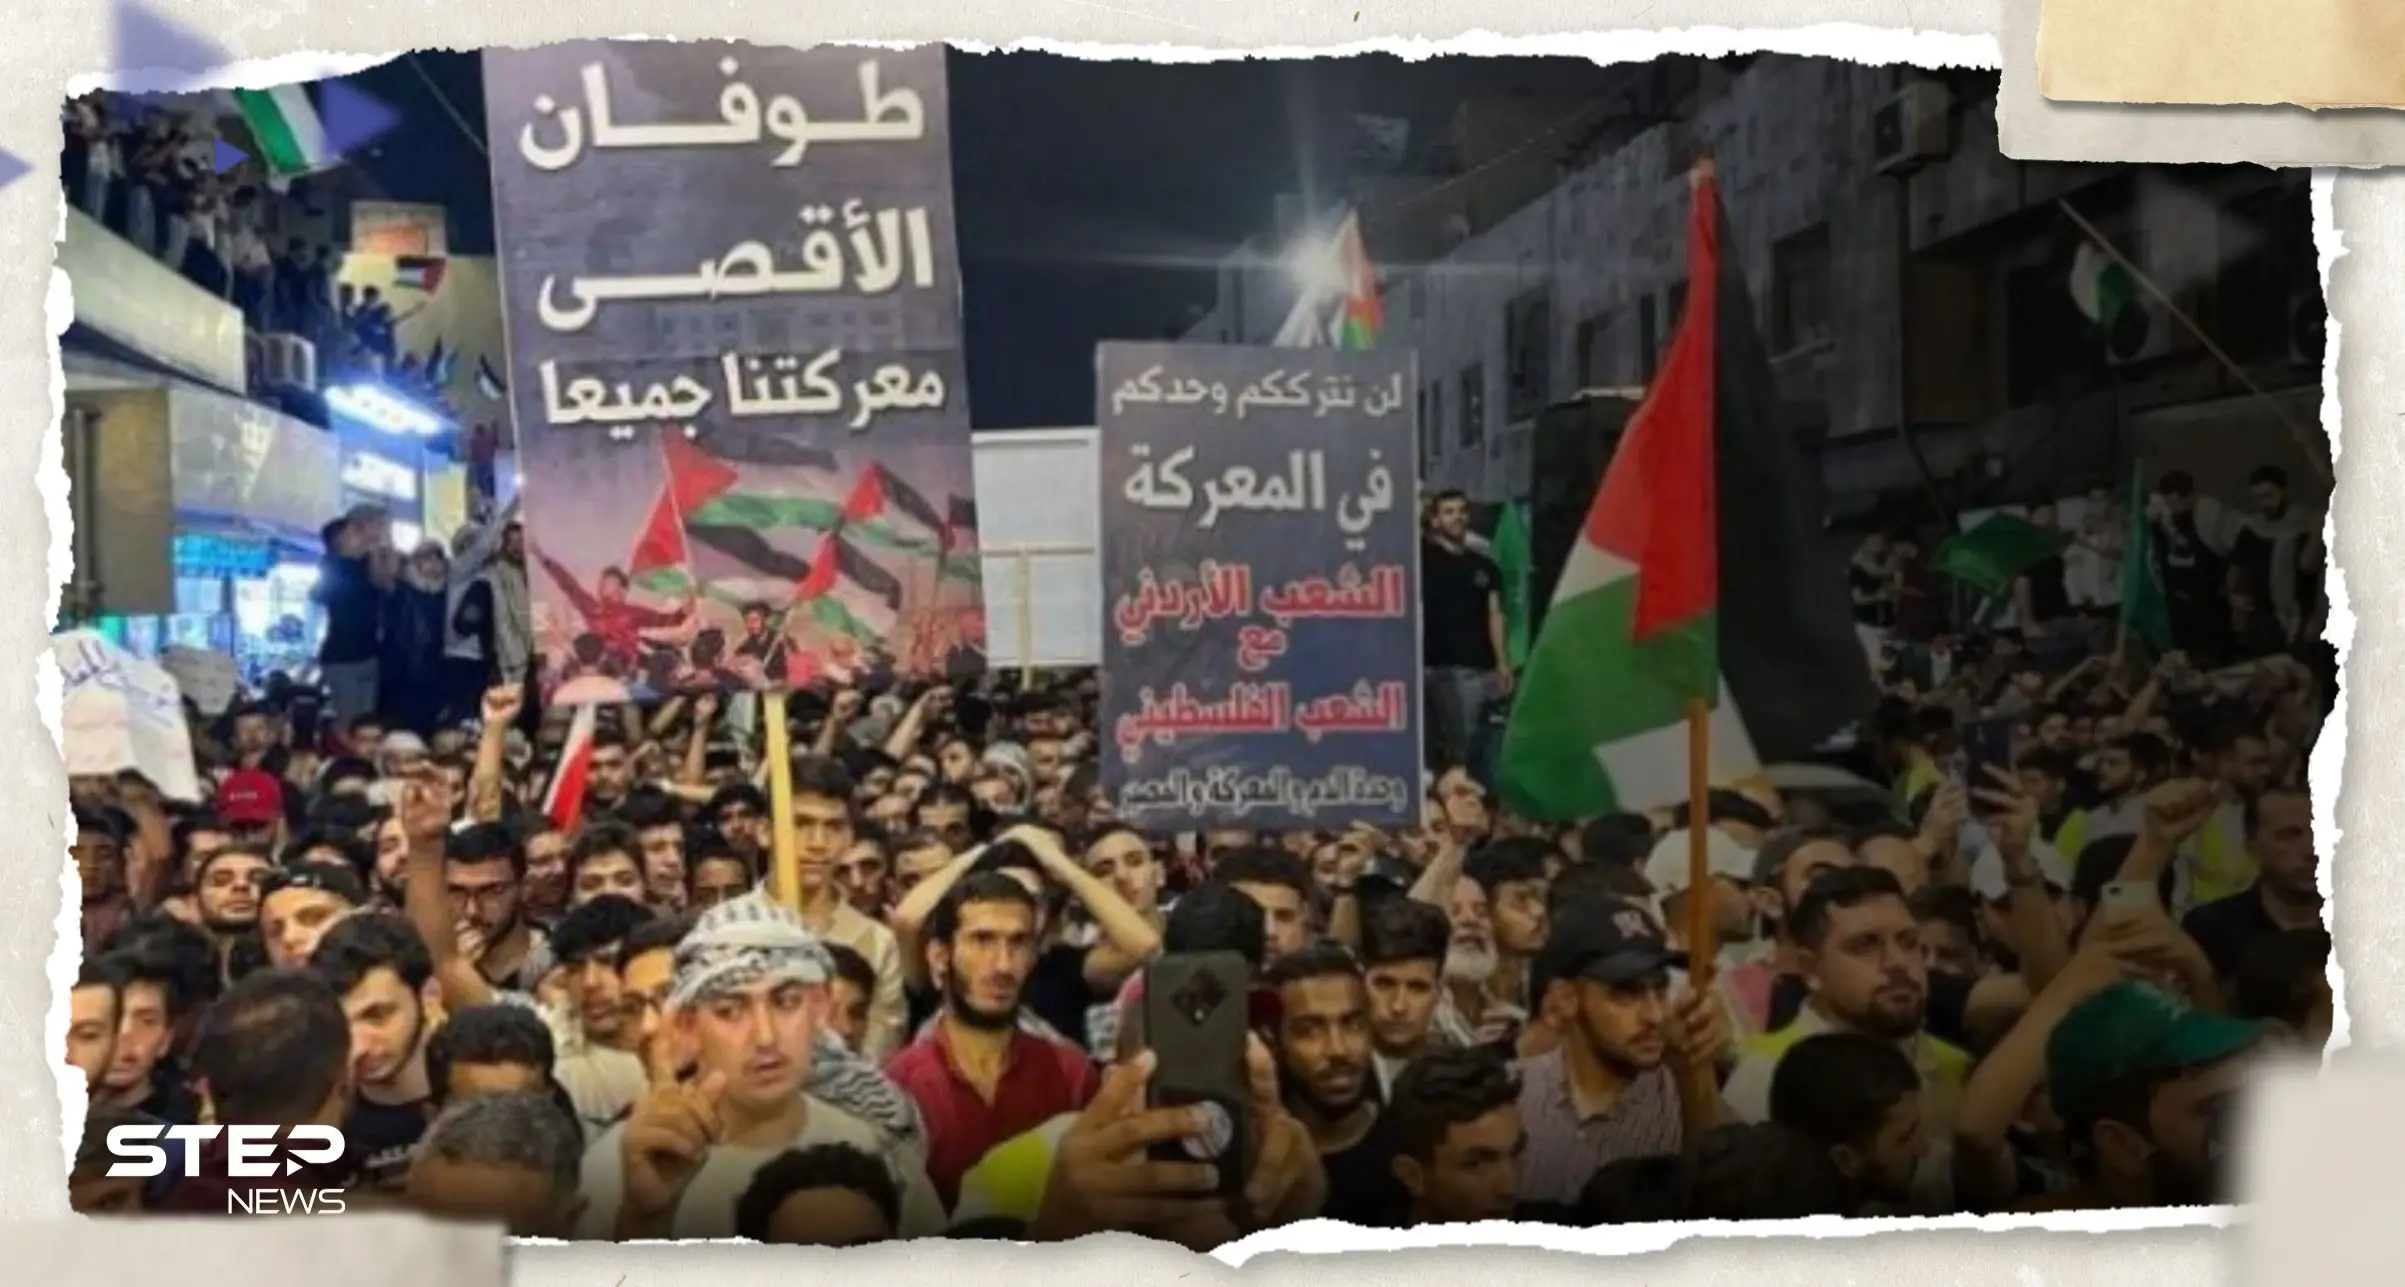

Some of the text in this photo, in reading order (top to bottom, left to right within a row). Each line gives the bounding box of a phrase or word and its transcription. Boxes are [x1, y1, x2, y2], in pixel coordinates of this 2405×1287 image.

[519, 56, 924, 170] طوفان
[537, 199, 933, 330] الأقصى
[538, 358, 712, 439] جميعا
[722, 348, 943, 430] معركتنا
[1111, 364, 1403, 420] لن نترككم وحدكم
[1124, 444, 1393, 551] في المعركة
[1114, 557, 1405, 647] الشعب الأردني
[1237, 625, 1289, 671] مع
[1115, 677, 1407, 764] الشعب الفلسطيني
